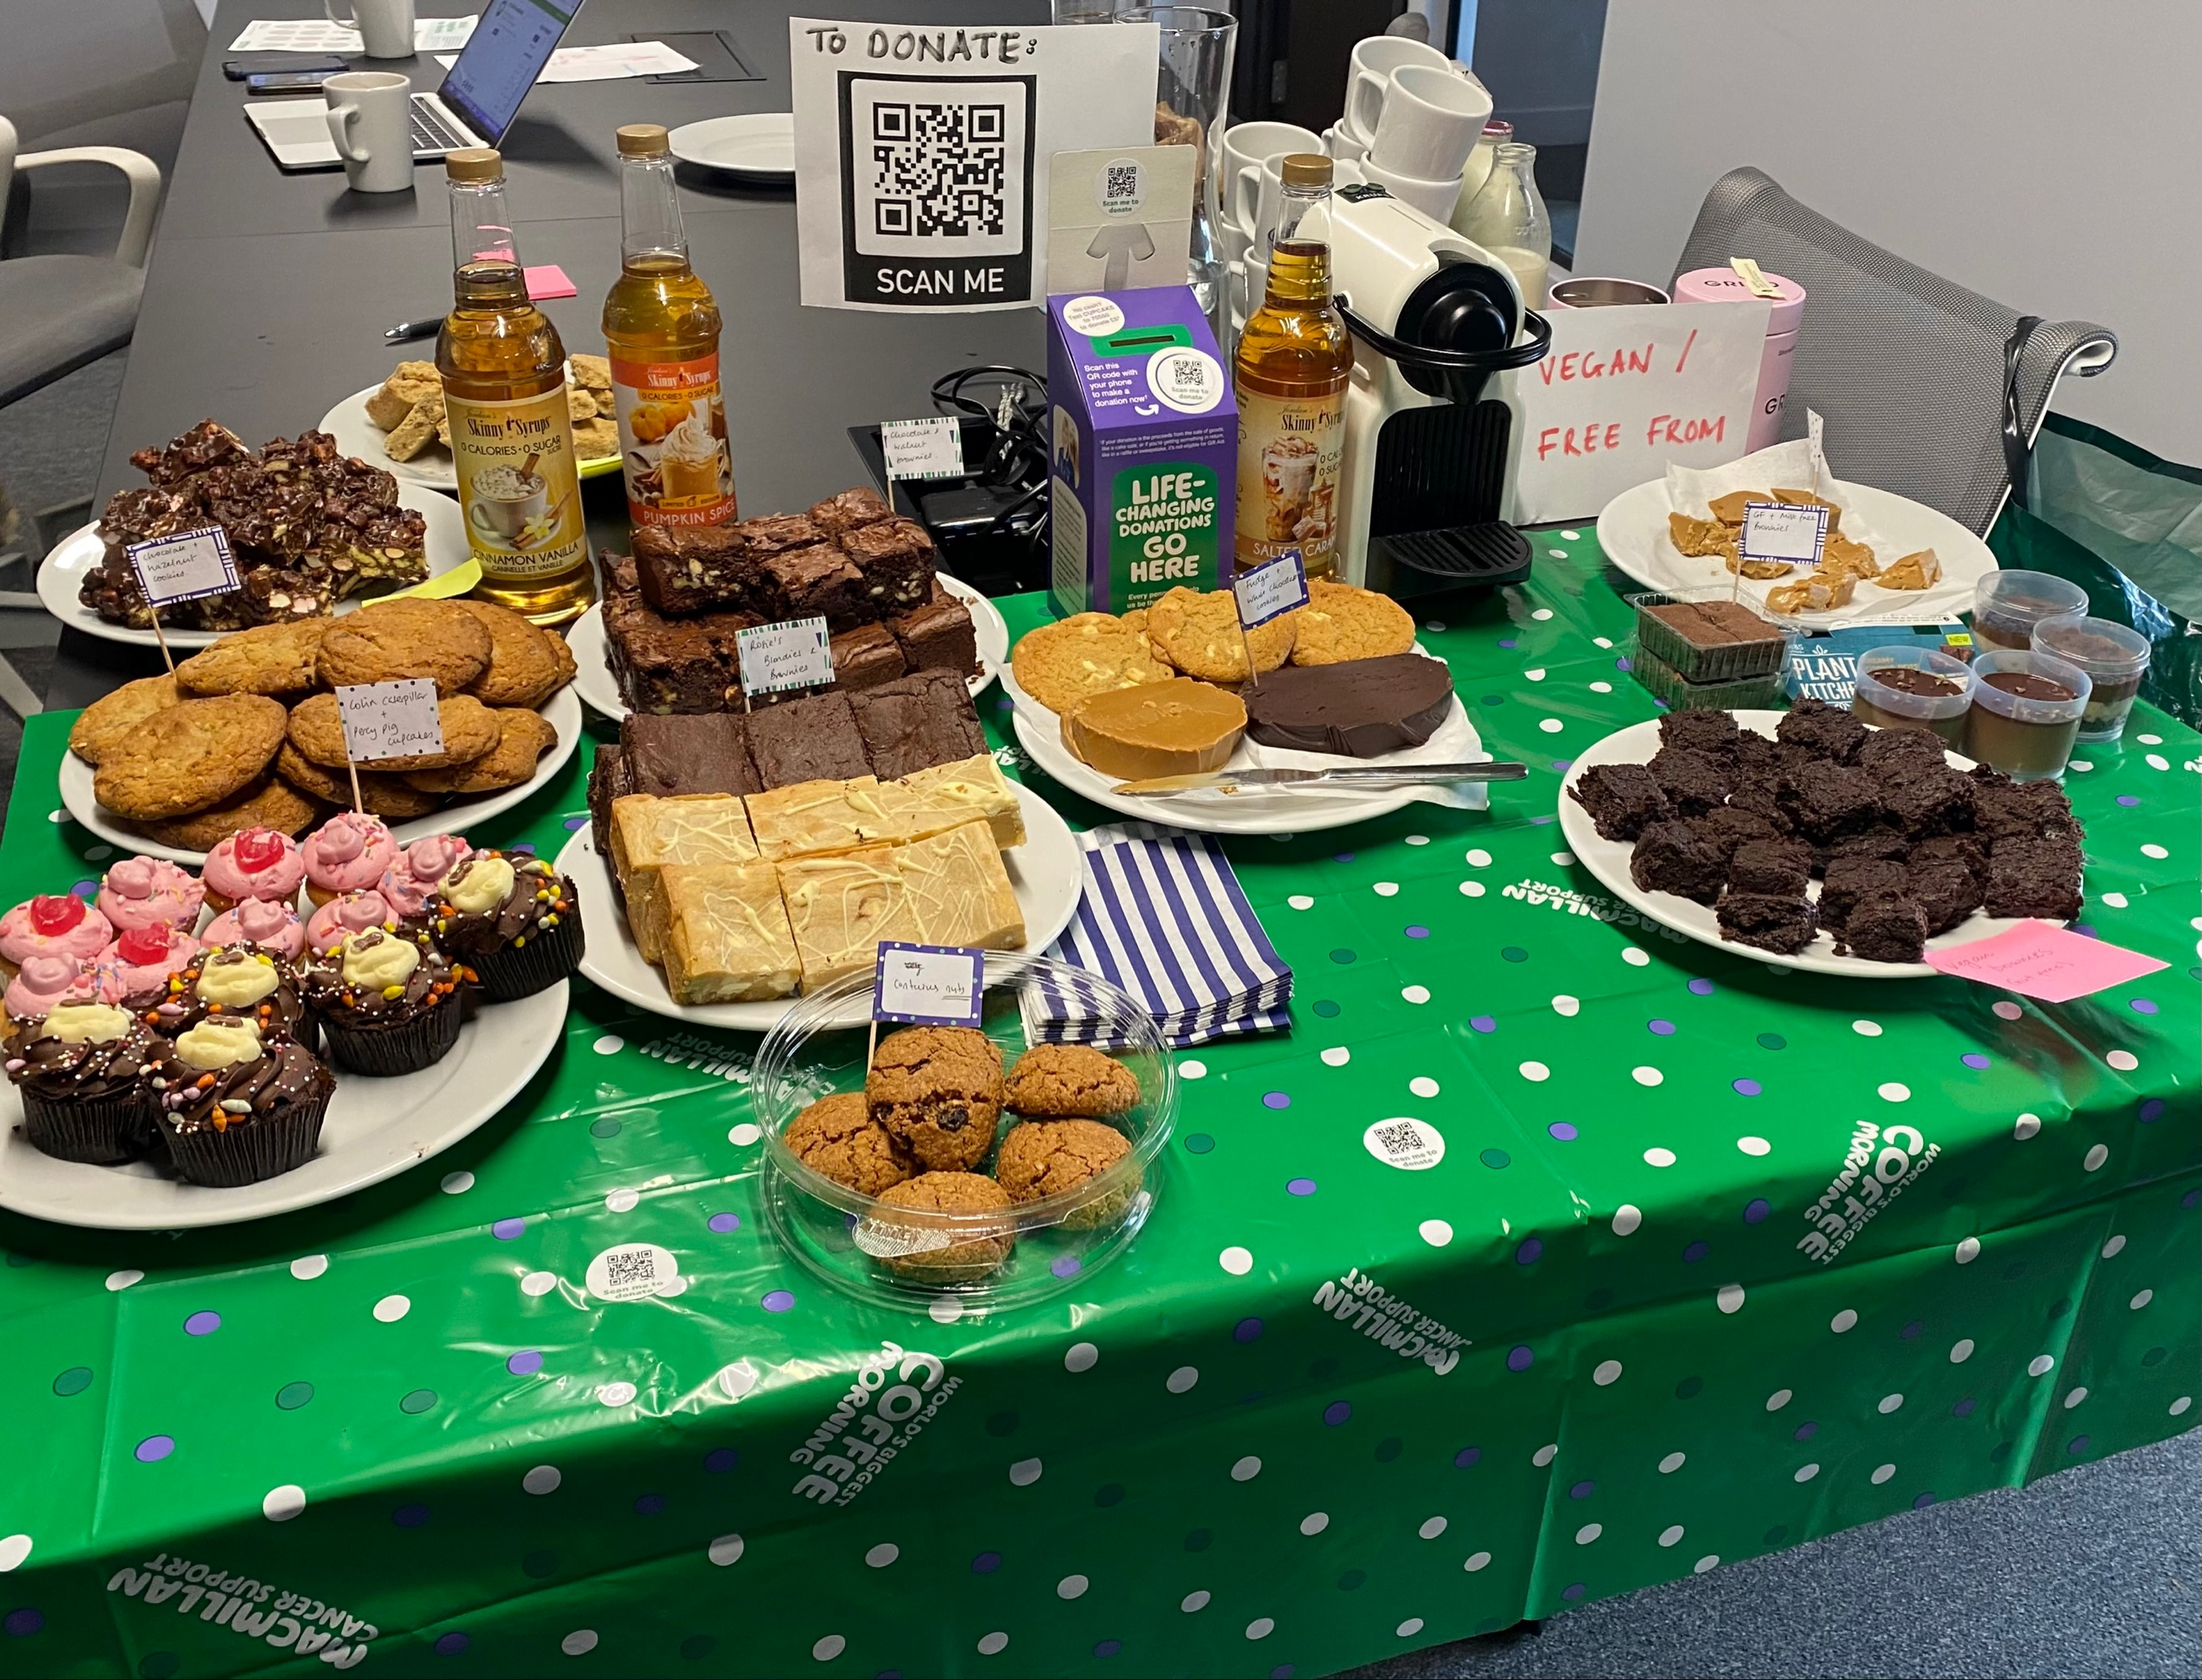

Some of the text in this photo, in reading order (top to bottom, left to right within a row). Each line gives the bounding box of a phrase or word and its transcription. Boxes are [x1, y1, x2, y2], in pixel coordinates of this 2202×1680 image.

[805, 26, 1037, 64] To DONATE:
[876, 268, 1005, 294] SCAN ME
[1704, 280, 1780, 288] GRID
[1082, 304, 1116, 317] CUPCAKE
[1538, 328, 1698, 386] VEGAN /
[1083, 362, 1120, 372] Scan this
[1087, 368, 1139, 380] QR code with
[648, 374, 678, 389] Skinny
[1089, 379, 1133, 391] your phone
[1172, 386, 1189, 394] Scan
[647, 392, 683, 400] CALORIES
[693, 386, 714, 398] SUGAR
[1091, 391, 1100, 399] to
[1101, 388, 1123, 397] make
[1095, 397, 1128, 408] donation
[467, 415, 551, 440] Skinny Syrups
[1281, 414, 1317, 434] Skinny
[461, 435, 561, 456] 0 CALORIES 0 SUGAR
[1537, 414, 1726, 461] FREE FROM
[1319, 455, 1326, 464] 0
[1318, 468, 1325, 477] 0
[1131, 472, 1206, 505] LIFE-
[643, 497, 736, 526] PUMPKIN SPICE
[1115, 496, 1215, 522] CHANGING
[1753, 510, 1765, 520] GF
[1119, 513, 1212, 538] DONATIONS
[473, 542, 579, 566] CINNAMON VANILLA
[1143, 533, 1187, 559] GO
[147, 554, 197, 572] hazelnut
[490, 565, 526, 573] CANNELLE
[527, 565, 536, 573] ET
[536, 559, 563, 570] VANILLE
[1130, 554, 1201, 584] HERE
[1245, 573, 1270, 590] Fudge
[1127, 593, 1148, 601] Every
[1256, 594, 1280, 611] cookies
[1790, 656, 1858, 682] PLANT
[1799, 682, 1857, 701] KITCHE
[349, 696, 378, 711] Colin
[380, 711, 388, 719] +
[387, 731, 434, 747] cupcakes
[1517, 878, 1610, 907] SUPPORT
[945, 982, 966, 995] nuts
[666, 1032, 757, 1065] SUPPORT
[1388, 1155, 1410, 1163] Scan
[1426, 1149, 1438, 1158] to
[1402, 1158, 1434, 1168] donate
[1803, 1119, 1881, 1223] MORNING
[1795, 1124, 1925, 1261] COFFEE
[1821, 1142, 1942, 1265] WORLD'S BIGGEST
[603, 1285, 629, 1296] Scan
[632, 1283, 648, 1291] me
[614, 1288, 654, 1299] donate
[1339, 1266, 1421, 1325] SUPPORT
[789, 1340, 904, 1466] MORNING
[791, 1351, 945, 1505] COFFEE
[833, 1375, 964, 1507] WORLD'S BIGGEST
[143, 1552, 380, 1642] CANCER SUPPORT
[106, 1567, 368, 1670] MACMILLAN
